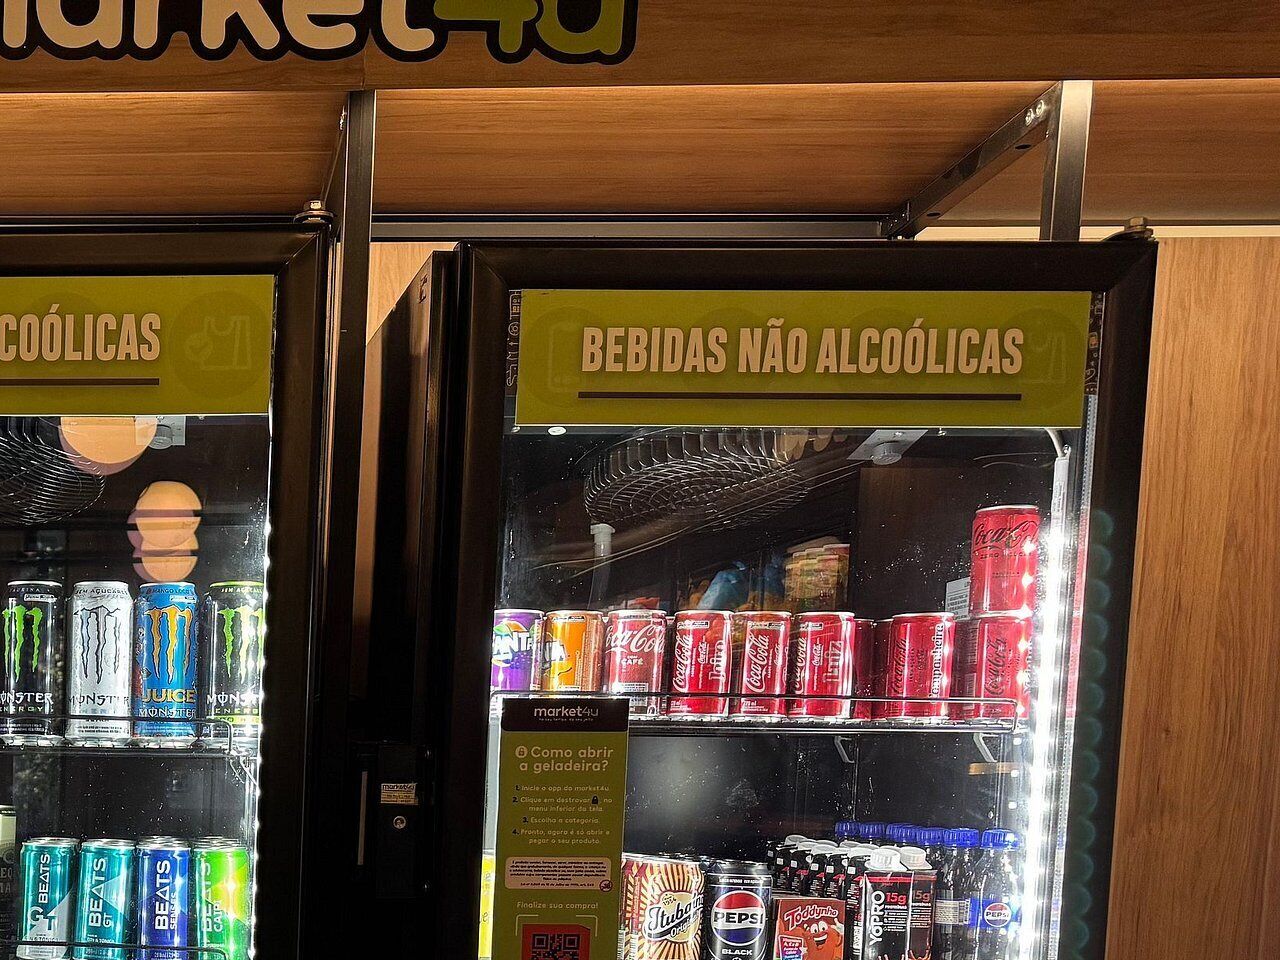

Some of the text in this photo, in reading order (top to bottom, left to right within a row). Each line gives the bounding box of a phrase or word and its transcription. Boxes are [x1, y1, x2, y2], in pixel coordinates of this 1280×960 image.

[581, 326, 728, 373] BEBIDAS
[738, 318, 809, 374] NÃO
[815, 318, 1024, 375] ALCOÓLICAS
[746, 632, 771, 693] Coca-Cola
[142, 688, 196, 704] JUICE
[533, 705, 599, 717] market4u
[530, 746, 614, 758] Como abrir
[519, 760, 609, 774] a geladeira?
[38, 853, 51, 904] BEATS
[88, 857, 106, 927] BEATS
[154, 860, 171, 931] BEATS
[886, 893, 907, 904] 15g
[516, 901, 546, 909] Finalize
[714, 911, 763, 924] PEPSI
[784, 904, 838, 931] Toddynho
[869, 890, 886, 945] YOPRO
[721, 948, 753, 956] BLACK
